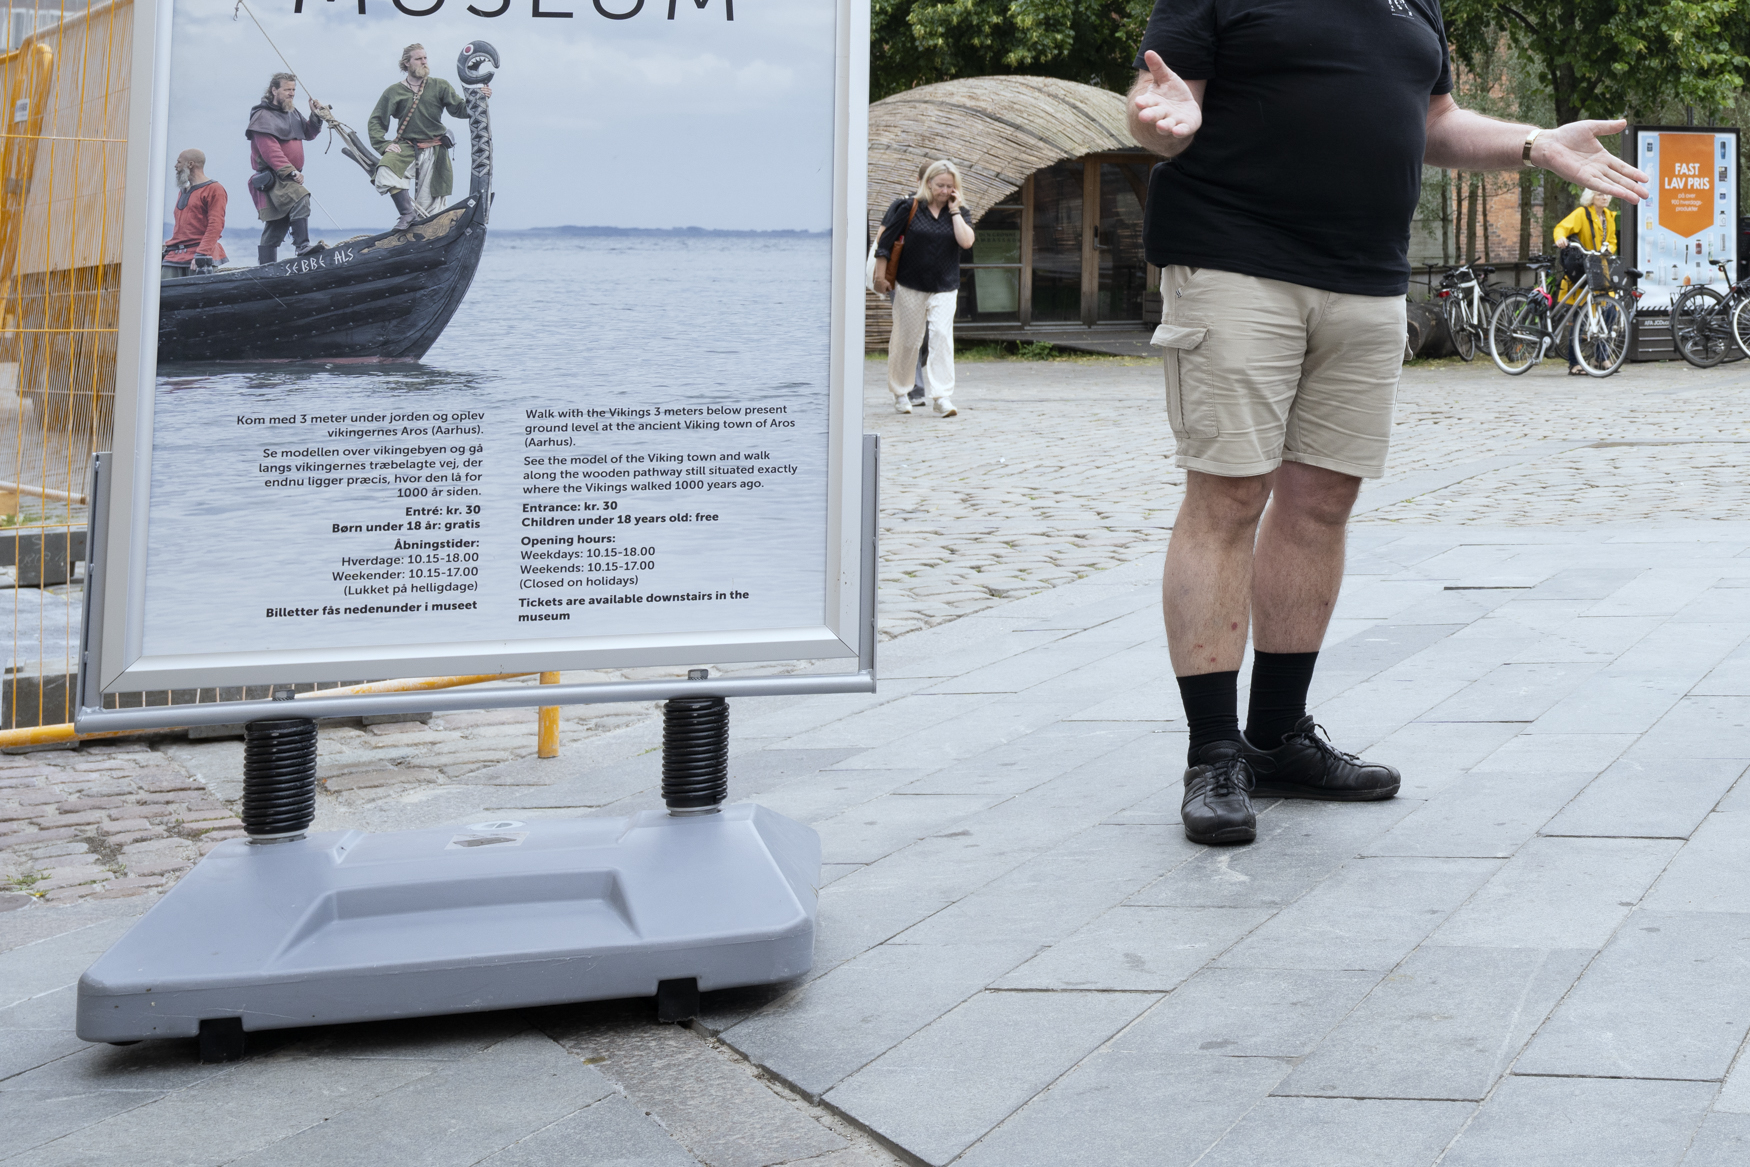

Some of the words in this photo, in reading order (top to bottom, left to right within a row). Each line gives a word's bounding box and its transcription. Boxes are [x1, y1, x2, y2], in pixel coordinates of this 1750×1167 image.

[1675, 163, 1700, 175] FAST
[1664, 177, 1685, 189] LAV
[1687, 177, 1710, 189] PRIS
[285, 255, 326, 276] SEBBE
[333, 247, 354, 265] ALS
[236, 411, 266, 425] Kom
[269, 414, 297, 425] med
[299, 414, 307, 424] 3
[310, 414, 348, 424] meter
[350, 412, 387, 423] under
[388, 411, 430, 425] jorden
[432, 413, 448, 423] og
[451, 410, 485, 423] oplev
[525, 409, 555, 419] Walk
[557, 408, 584, 418] with
[586, 407, 606, 418] the
[609, 407, 652, 419] Vikings
[653, 406, 661, 417] 3
[663, 407, 704, 416] meters
[706, 405, 742, 416] below
[744, 405, 788, 417] present
[327, 427, 398, 440] vikingernes
[400, 426, 428, 436] Aros
[431, 424, 484, 436] (Aarhus).
[524, 422, 568, 436] ground
[571, 422, 599, 432] level
[601, 422, 613, 432] at
[615, 421, 636, 431] the
[638, 420, 682, 431] ancient
[684, 419, 720, 432] Viking
[723, 420, 753, 429] town
[755, 418, 768, 428] of
[769, 418, 796, 428] Aros
[524, 436, 576, 448] (Aarhus).
[263, 448, 278, 459] Se
[281, 447, 340, 458] modellen
[342, 448, 371, 457] over
[373, 444, 447, 457] vikingebyen
[449, 445, 466, 456] og
[468, 443, 483, 456] gå
[523, 456, 545, 466] See
[547, 455, 568, 465] the
[570, 454, 608, 465] model
[610, 454, 623, 464] of
[625, 453, 645, 464] the
[647, 452, 684, 465] Viking
[686, 453, 717, 462] town
[719, 451, 741, 461] and
[743, 450, 770, 461] walk
[259, 463, 292, 475] langs
[294, 461, 366, 474] vikingernes
[369, 459, 436, 471] træbelagte
[439, 458, 459, 470] vej,
[462, 457, 484, 468] der
[523, 470, 557, 482] along
[559, 469, 579, 479] the
[582, 468, 630, 479] wooden
[633, 467, 683, 480] pathway
[685, 466, 706, 476] still
[708, 464, 755, 476] situated
[757, 463, 798, 476] exactly
[264, 477, 305, 488] endnu
[308, 476, 344, 488] ligger
[346, 474, 391, 487] præcis,
[394, 473, 423, 484] hvor
[425, 473, 448, 483] den
[451, 472, 462, 482] lå
[464, 471, 483, 482] for
[522, 484, 560, 494] where
[562, 483, 583, 493] the
[585, 482, 628, 494] Vikings
[630, 480, 672, 491] walked
[675, 479, 704, 490] 1000
[706, 481, 737, 492] years
[739, 480, 764, 491] ago.
[396, 487, 428, 498] 1000
[431, 487, 444, 497] år
[446, 486, 482, 497] siden.
[405, 505, 443, 517] Entré:
[446, 505, 462, 515] kr.
[465, 504, 481, 515] 30
[522, 503, 581, 513] Entrance:
[584, 501, 600, 511] kr.
[602, 500, 618, 511] 30
[332, 523, 363, 533] Børn
[365, 521, 404, 532] under
[406, 520, 422, 531] 18
[424, 520, 441, 531] år:
[444, 519, 481, 532] gratis
[521, 516, 575, 527] Children
[578, 515, 615, 526] under
[617, 514, 632, 524] 18
[634, 515, 667, 526] years
[668, 512, 692, 523] old:
[695, 512, 719, 522] free
[393, 538, 480, 552] Åbningstider:
[520, 535, 574, 548] Opening
[577, 534, 616, 544] hours:
[341, 555, 404, 568] Hverdage:
[407, 552, 479, 564] 10.15-18.00
[520, 549, 583, 561] Weekdays:
[586, 546, 656, 558] 10.15-18.00
[332, 569, 405, 582] Weekender:
[408, 566, 479, 579] 10.15-17.00
[520, 563, 584, 575] Weekends:
[587, 560, 655, 572] 10.15-17.00
[343, 584, 390, 597] (Lukket
[392, 583, 408, 596] på
[410, 580, 478, 595] helligdage)
[519, 577, 564, 590] (Closed
[567, 579, 583, 587] on
[586, 574, 639, 588] holidays)
[518, 597, 563, 608] Tickets
[565, 598, 586, 606] are
[588, 593, 644, 605] available
[645, 591, 713, 603] downstairs
[715, 590, 727, 600] in
[729, 590, 750, 600] the
[266, 607, 320, 618] Billetter
[322, 605, 341, 616] fås
[343, 602, 422, 615] nedenunder
[424, 601, 429, 612] i
[431, 600, 478, 611] museet
[518, 612, 571, 622] museum
